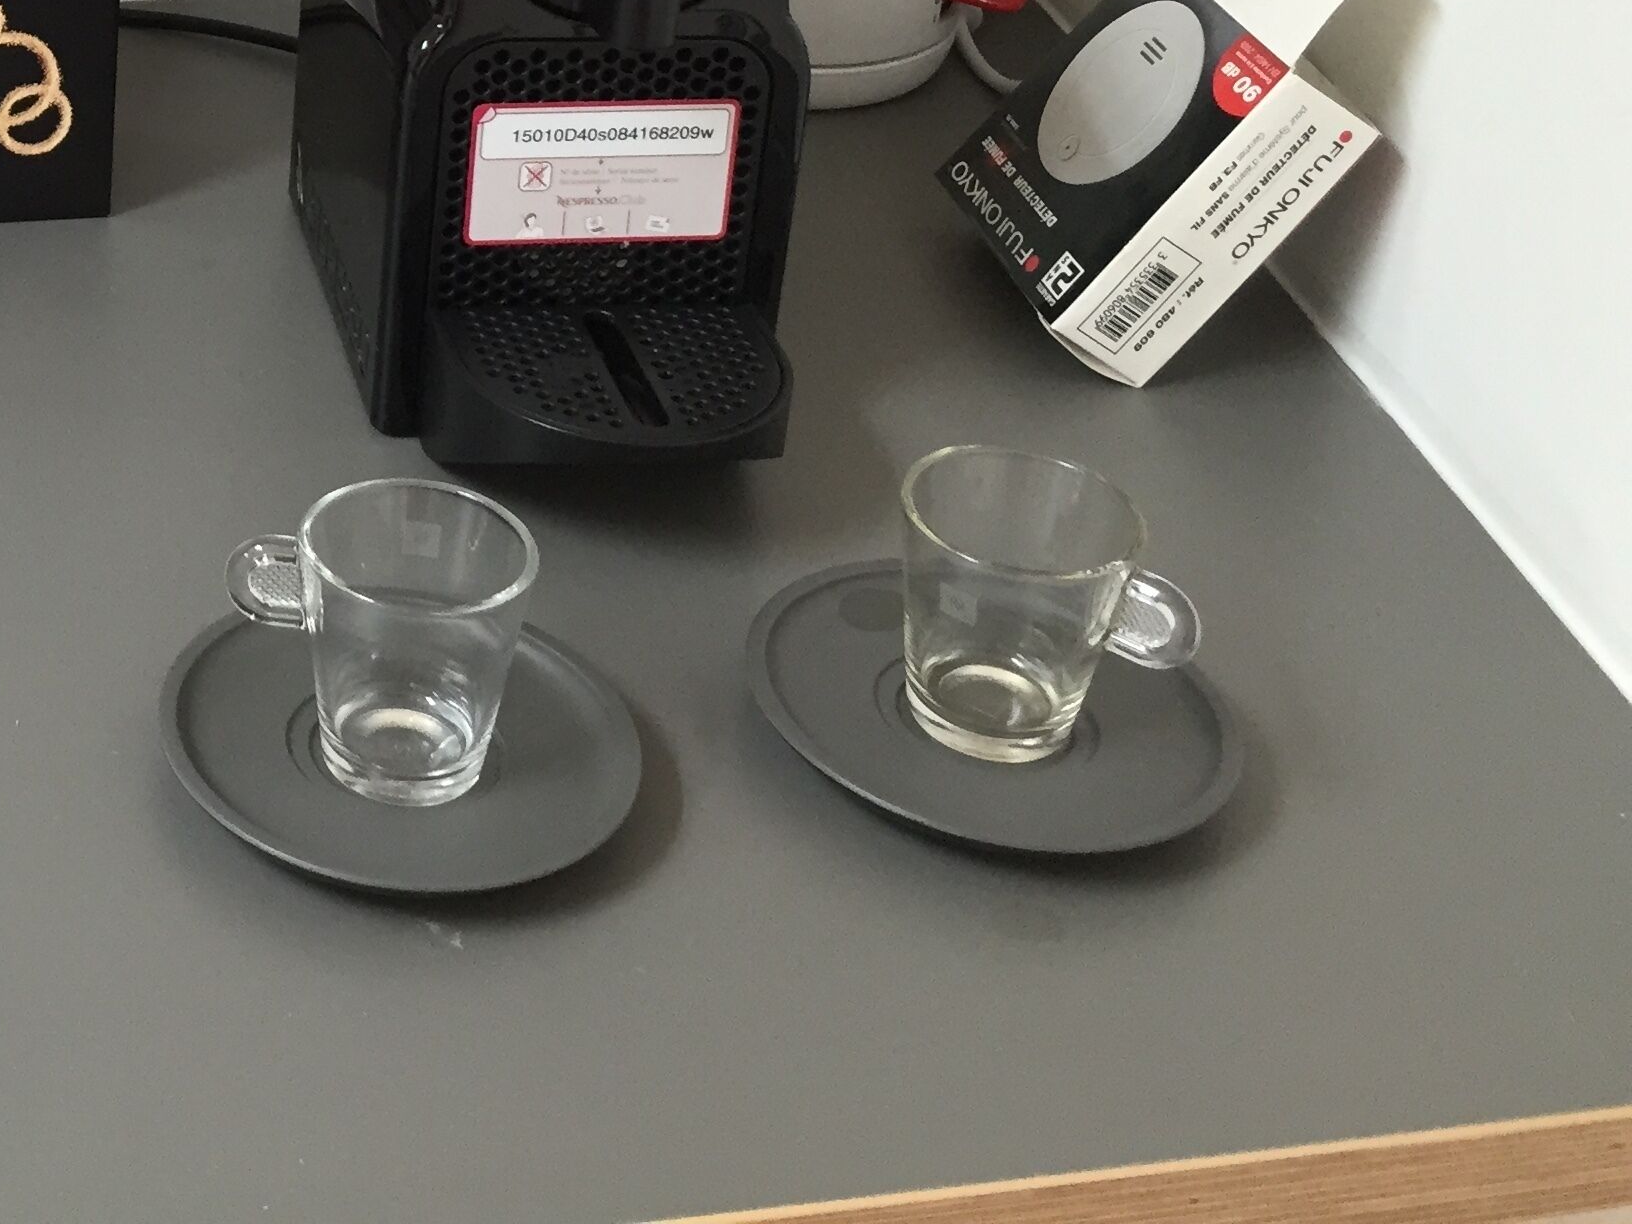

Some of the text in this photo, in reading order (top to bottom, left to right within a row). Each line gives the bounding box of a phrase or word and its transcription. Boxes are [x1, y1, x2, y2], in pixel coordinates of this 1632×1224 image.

[1221, 62, 1240, 77] dB
[1233, 76, 1262, 102] 90
[513, 127, 714, 142] 15010D40s084168209w
[982, 136, 1007, 166] FUMÉE
[1001, 161, 1016, 177] DE
[1211, 125, 1317, 239] DÉTECTEUR DE FUMÉE
[1013, 175, 1058, 227] DÉTECTEUR
[1205, 192, 1229, 216] SANS
[1231, 141, 1344, 259] FUJI ONKYO
[951, 161, 1034, 265] FUJI ONKYO
[1190, 217, 1206, 230] FIL
[1157, 251, 1168, 260] 3
[1049, 260, 1080, 295] 2
[1155, 306, 1175, 329] 480
[1134, 329, 1155, 351] 609
